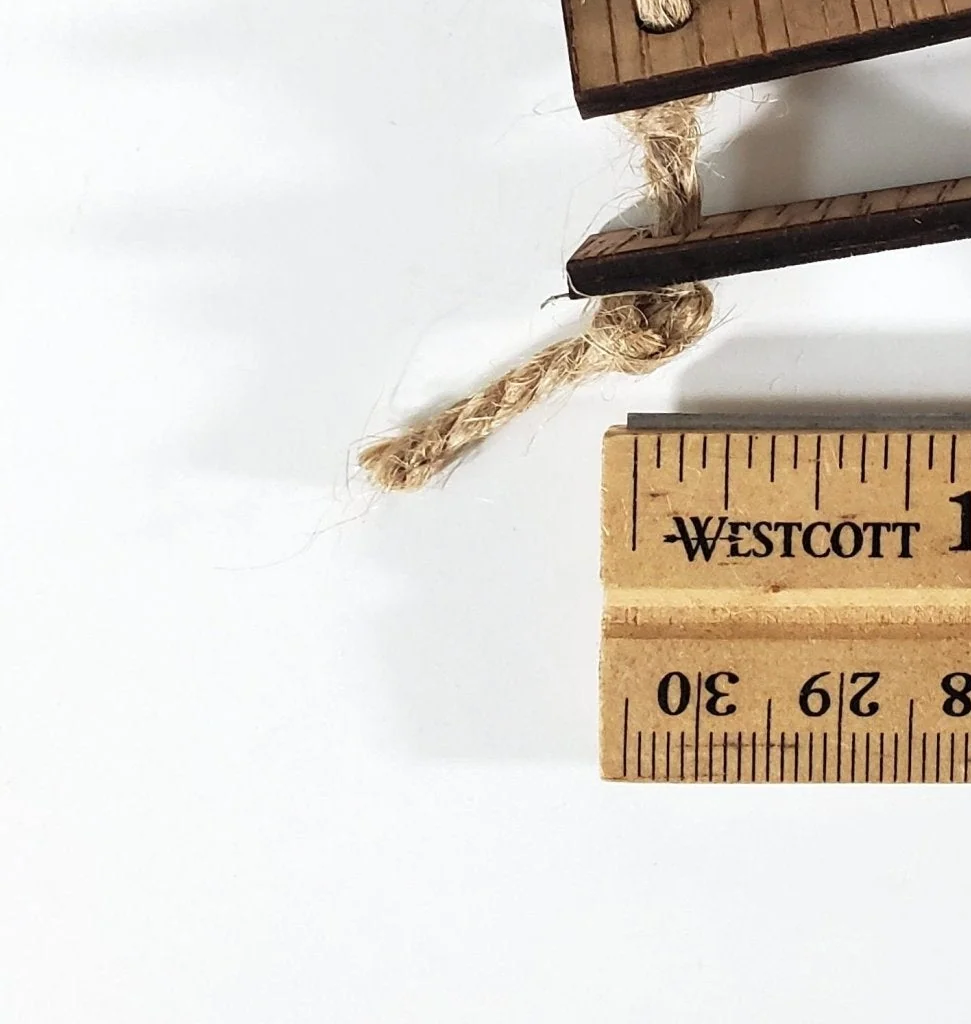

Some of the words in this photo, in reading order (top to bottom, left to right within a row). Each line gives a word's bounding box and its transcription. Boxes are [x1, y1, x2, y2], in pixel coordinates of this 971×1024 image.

[664, 516, 920, 562] WESTCOTT
[656, 671, 740, 716] 30
[800, 671, 880, 717] 29
